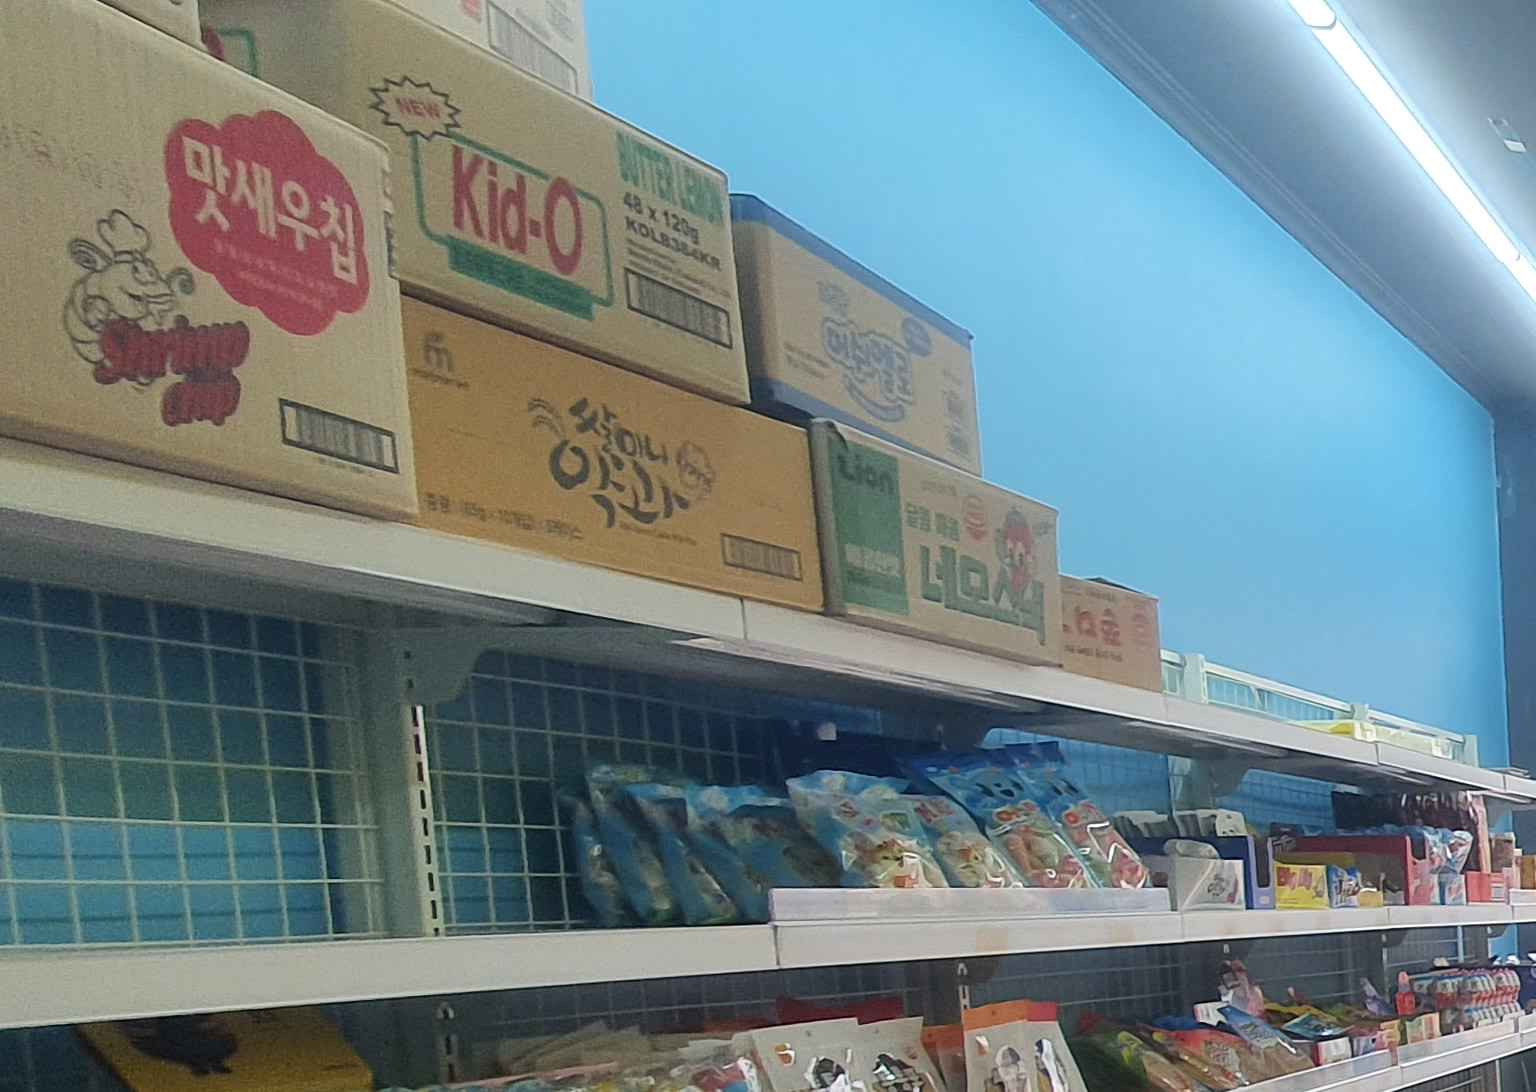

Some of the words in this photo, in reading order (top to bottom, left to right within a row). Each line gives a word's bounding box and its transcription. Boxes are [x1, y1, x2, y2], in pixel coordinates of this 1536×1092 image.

[397, 98, 441, 119] NEW
[181, 135, 358, 286] 맛새우칩
[452, 144, 583, 276] Kid-O
[623, 191, 641, 216] 48
[663, 209, 700, 247] 120g
